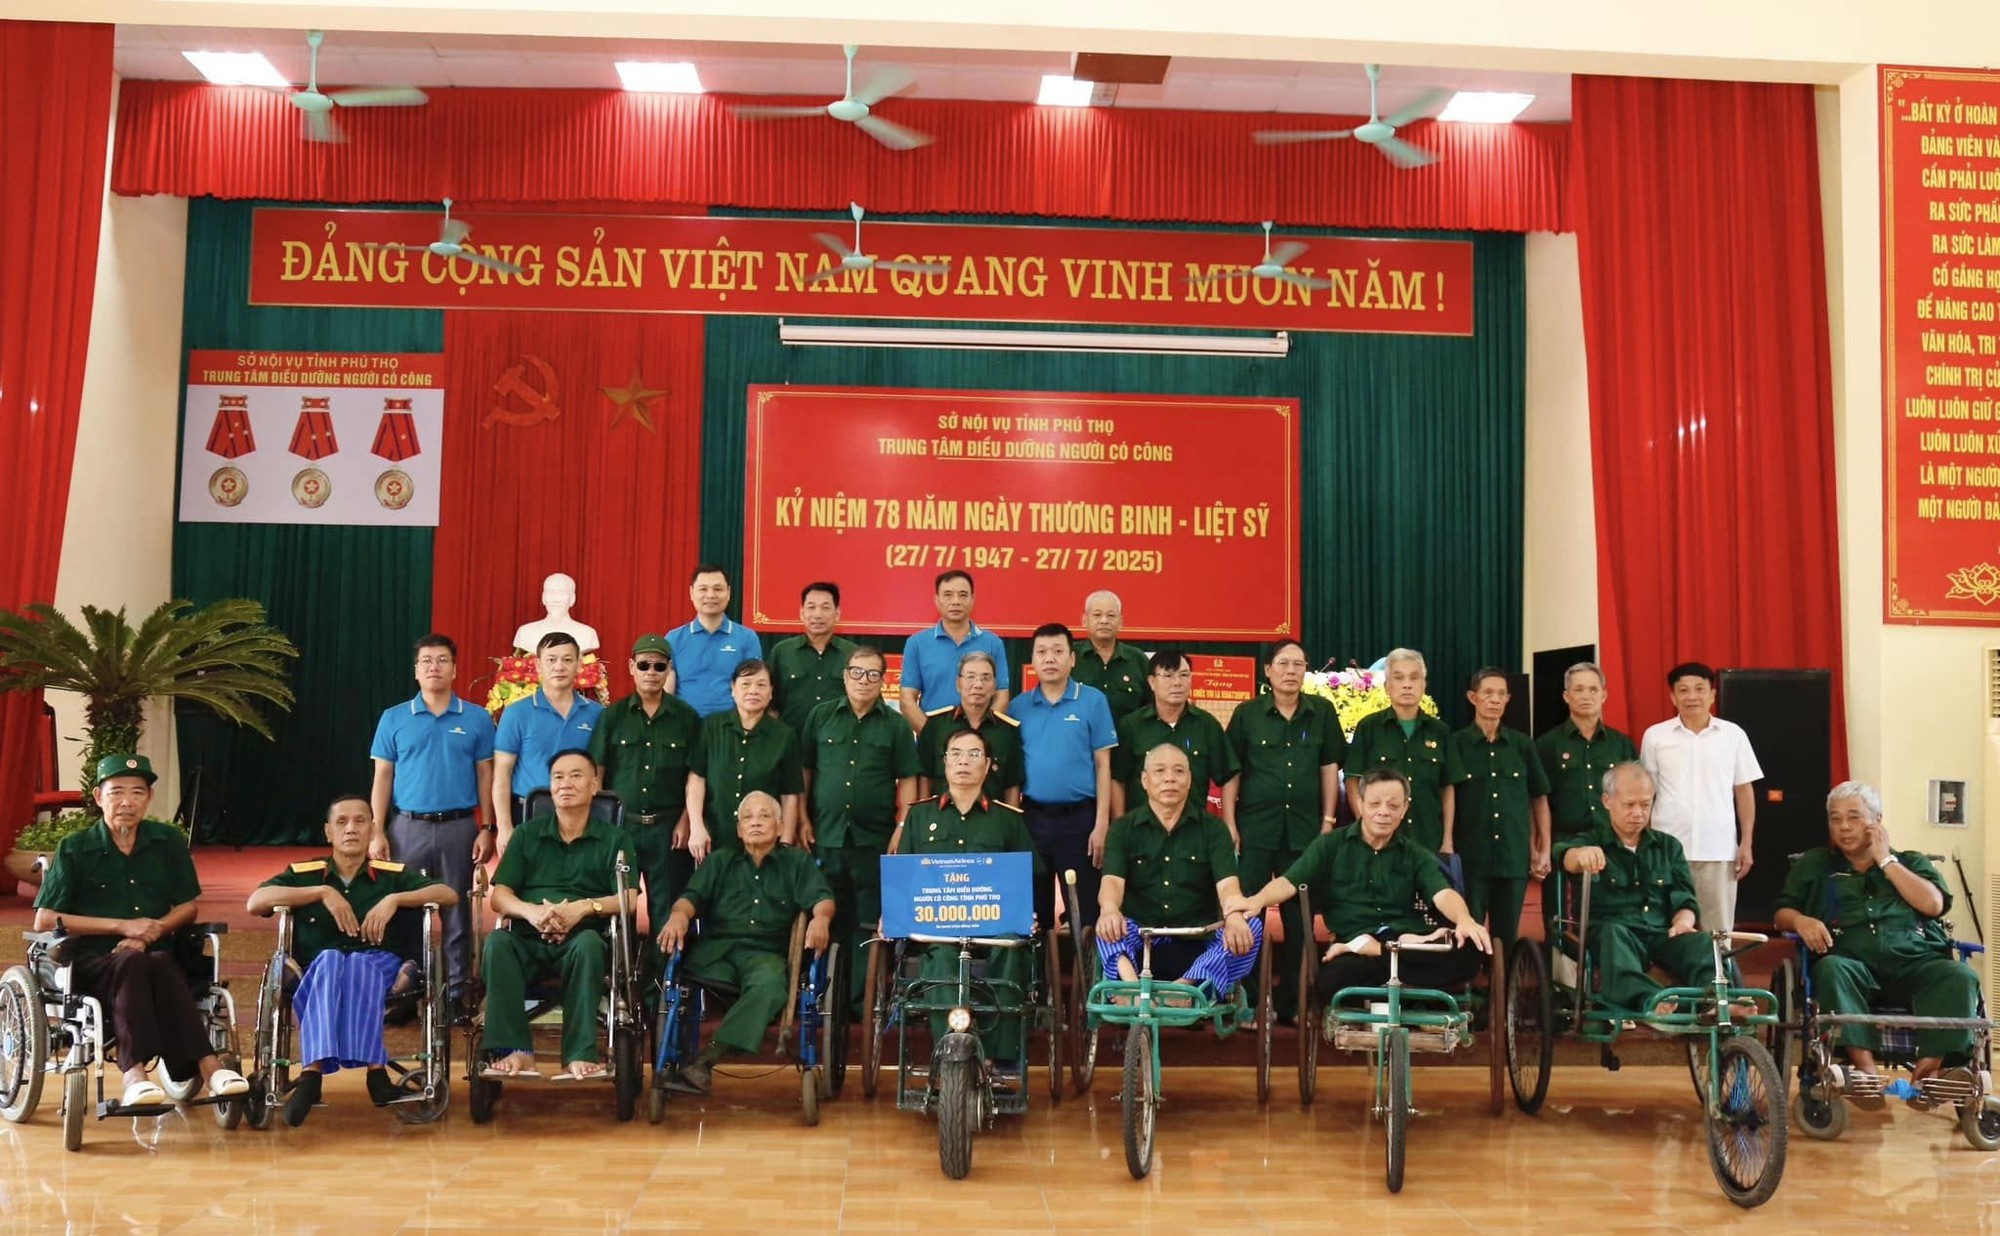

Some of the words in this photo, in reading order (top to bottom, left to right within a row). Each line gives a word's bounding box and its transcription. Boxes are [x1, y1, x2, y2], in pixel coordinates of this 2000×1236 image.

[1936, 100, 1951, 123] KỲ
[1954, 96, 1964, 124] Ở
[1965, 101, 1997, 126] HOÀN
[1921, 128, 1953, 156] ĐẢNG
[1956, 133, 1983, 157] VIÊN
[1949, 162, 1977, 189] PHẢI
[1929, 201, 1946, 221] RA
[1948, 196, 1972, 222] SỨC
[1932, 234, 1948, 254] RA
[1951, 229, 1975, 255] SỨC
[281, 221, 409, 283] ĐẢNG
[421, 232, 545, 296] CỘNG
[556, 227, 647, 288] SẢN
[659, 235, 763, 301] VIỆT
[775, 252, 878, 294] NAM
[890, 253, 1049, 299] QUANG
[1060, 258, 1173, 301] VINH
[1327, 257, 1426, 311] NĂM
[1933, 260, 1949, 287] CỐ
[1952, 261, 1984, 289] GẮNG
[1917, 291, 1933, 319] ĐỂ
[1935, 296, 1968, 320] NÂNG
[1971, 301, 1994, 322] CAO
[1921, 328, 1945, 353] VĂN
[1977, 334, 1996, 355] TRI
[238, 351, 257, 367] SỞ
[259, 352, 282, 369] NỘI
[285, 355, 303, 369] VỤ
[306, 352, 337, 367] TỈNH
[340, 355, 368, 368] PHÚ
[371, 357, 399, 370] THỌ
[203, 369, 241, 383] TRUNG
[243, 368, 268, 383] TÂM
[343, 370, 379, 386] NGƯỜI
[382, 371, 398, 386] CÓ
[400, 371, 432, 386] CÔNG
[1926, 361, 1962, 386] CHÍNH
[1964, 366, 1983, 391] TRỊ
[1905, 394, 1936, 419] LUÔN
[1939, 395, 1969, 420] LUÔN
[1972, 396, 1994, 421] GIỮ
[937, 411, 959, 429] SỞ
[962, 413, 988, 434] NỘI
[992, 416, 1011, 435] VỤ
[1015, 413, 1049, 431] TỈNH
[1053, 415, 1082, 433] PHÚ
[1086, 419, 1114, 437] THỌ
[878, 437, 927, 456] TRUNG
[931, 436, 963, 457] TÂM
[967, 435, 1001, 458] ĐIỀU
[1005, 438, 1056, 460] DƯỠNG
[1059, 441, 1105, 461] NGƯỜI
[1108, 442, 1128, 461] CÓ
[1132, 441, 1173, 463] CÔNG
[1920, 428, 1951, 452] LUÔN
[1953, 429, 1984, 453] LUÔN
[1920, 460, 1935, 485] LÀ
[1937, 462, 1963, 490] MỘT
[776, 487, 805, 527] KỶ
[810, 491, 867, 535] NIỆM
[873, 499, 901, 530] 78
[907, 494, 958, 531] NĂM
[964, 495, 1023, 532] NGÀY
[1028, 500, 1115, 535] THƯƠNG
[1120, 504, 1173, 535] BINH
[1179, 518, 1188, 527] -
[1194, 501, 1237, 543] LIỆT
[1243, 502, 1270, 538] SỸ
[1918, 494, 1943, 523] MỘT
[1946, 495, 1982, 520] NGƯỜI
[962, 546, 1015, 569] 1947
[1102, 548, 1163, 574] 2025)
[944, 872, 970, 884] TẶNG
[914, 903, 1001, 923] 30.000.000
